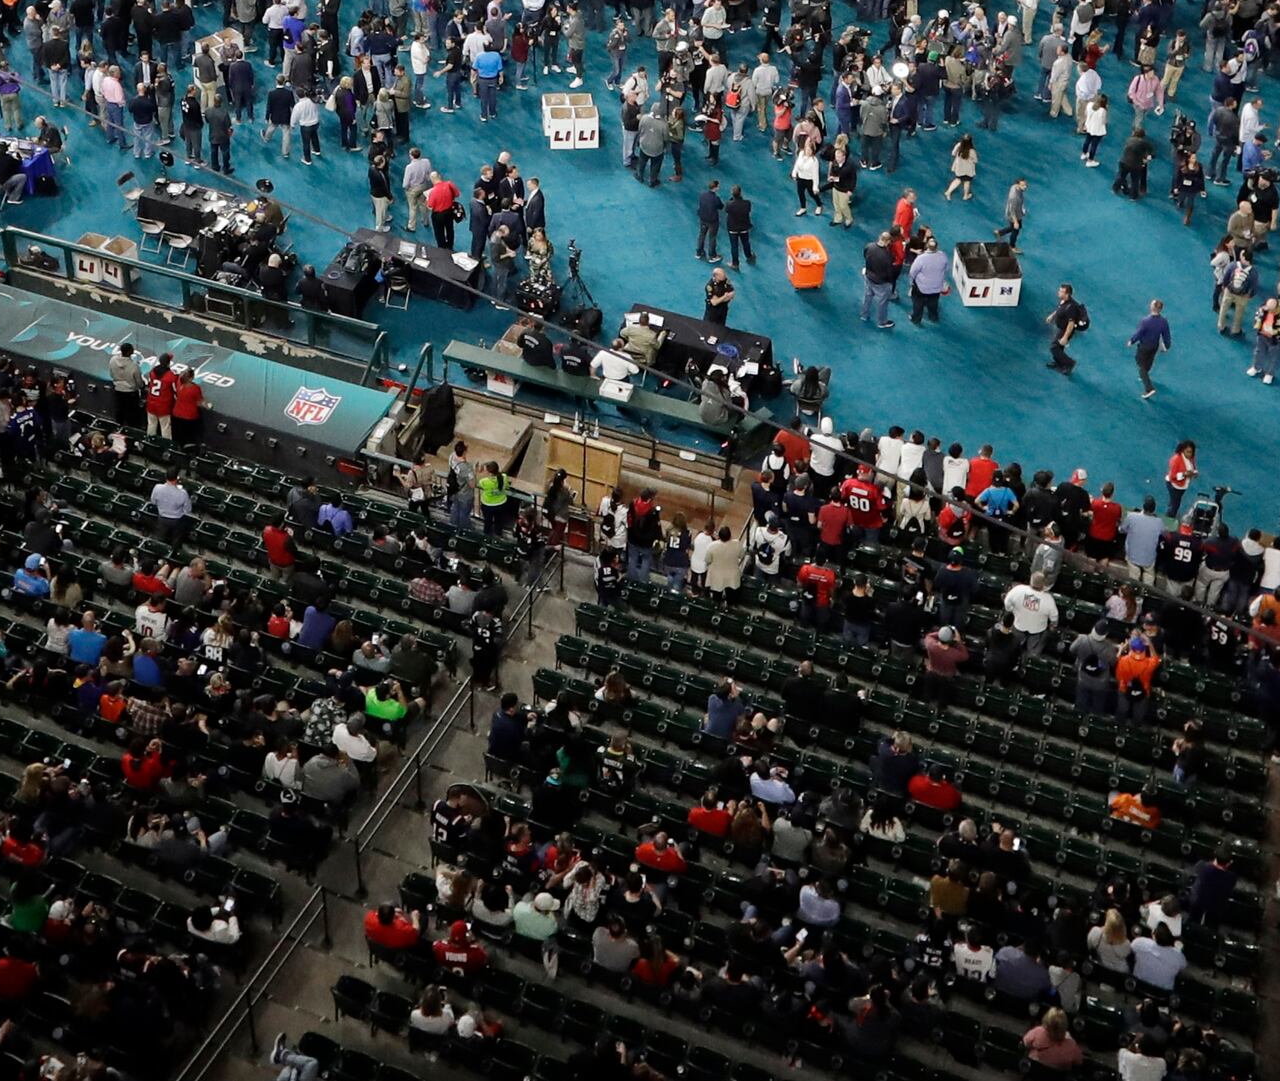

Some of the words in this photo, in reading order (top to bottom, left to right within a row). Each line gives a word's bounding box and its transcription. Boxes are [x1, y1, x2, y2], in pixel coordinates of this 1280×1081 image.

[554, 130, 571, 142] LI
[579, 130, 596, 142] LI
[79, 260, 94, 274] LI
[104, 262, 118, 279] LI
[969, 286, 991, 299] LI
[849, 495, 870, 512] 80
[669, 536, 681, 549] 12
[1173, 547, 1193, 563] 99
